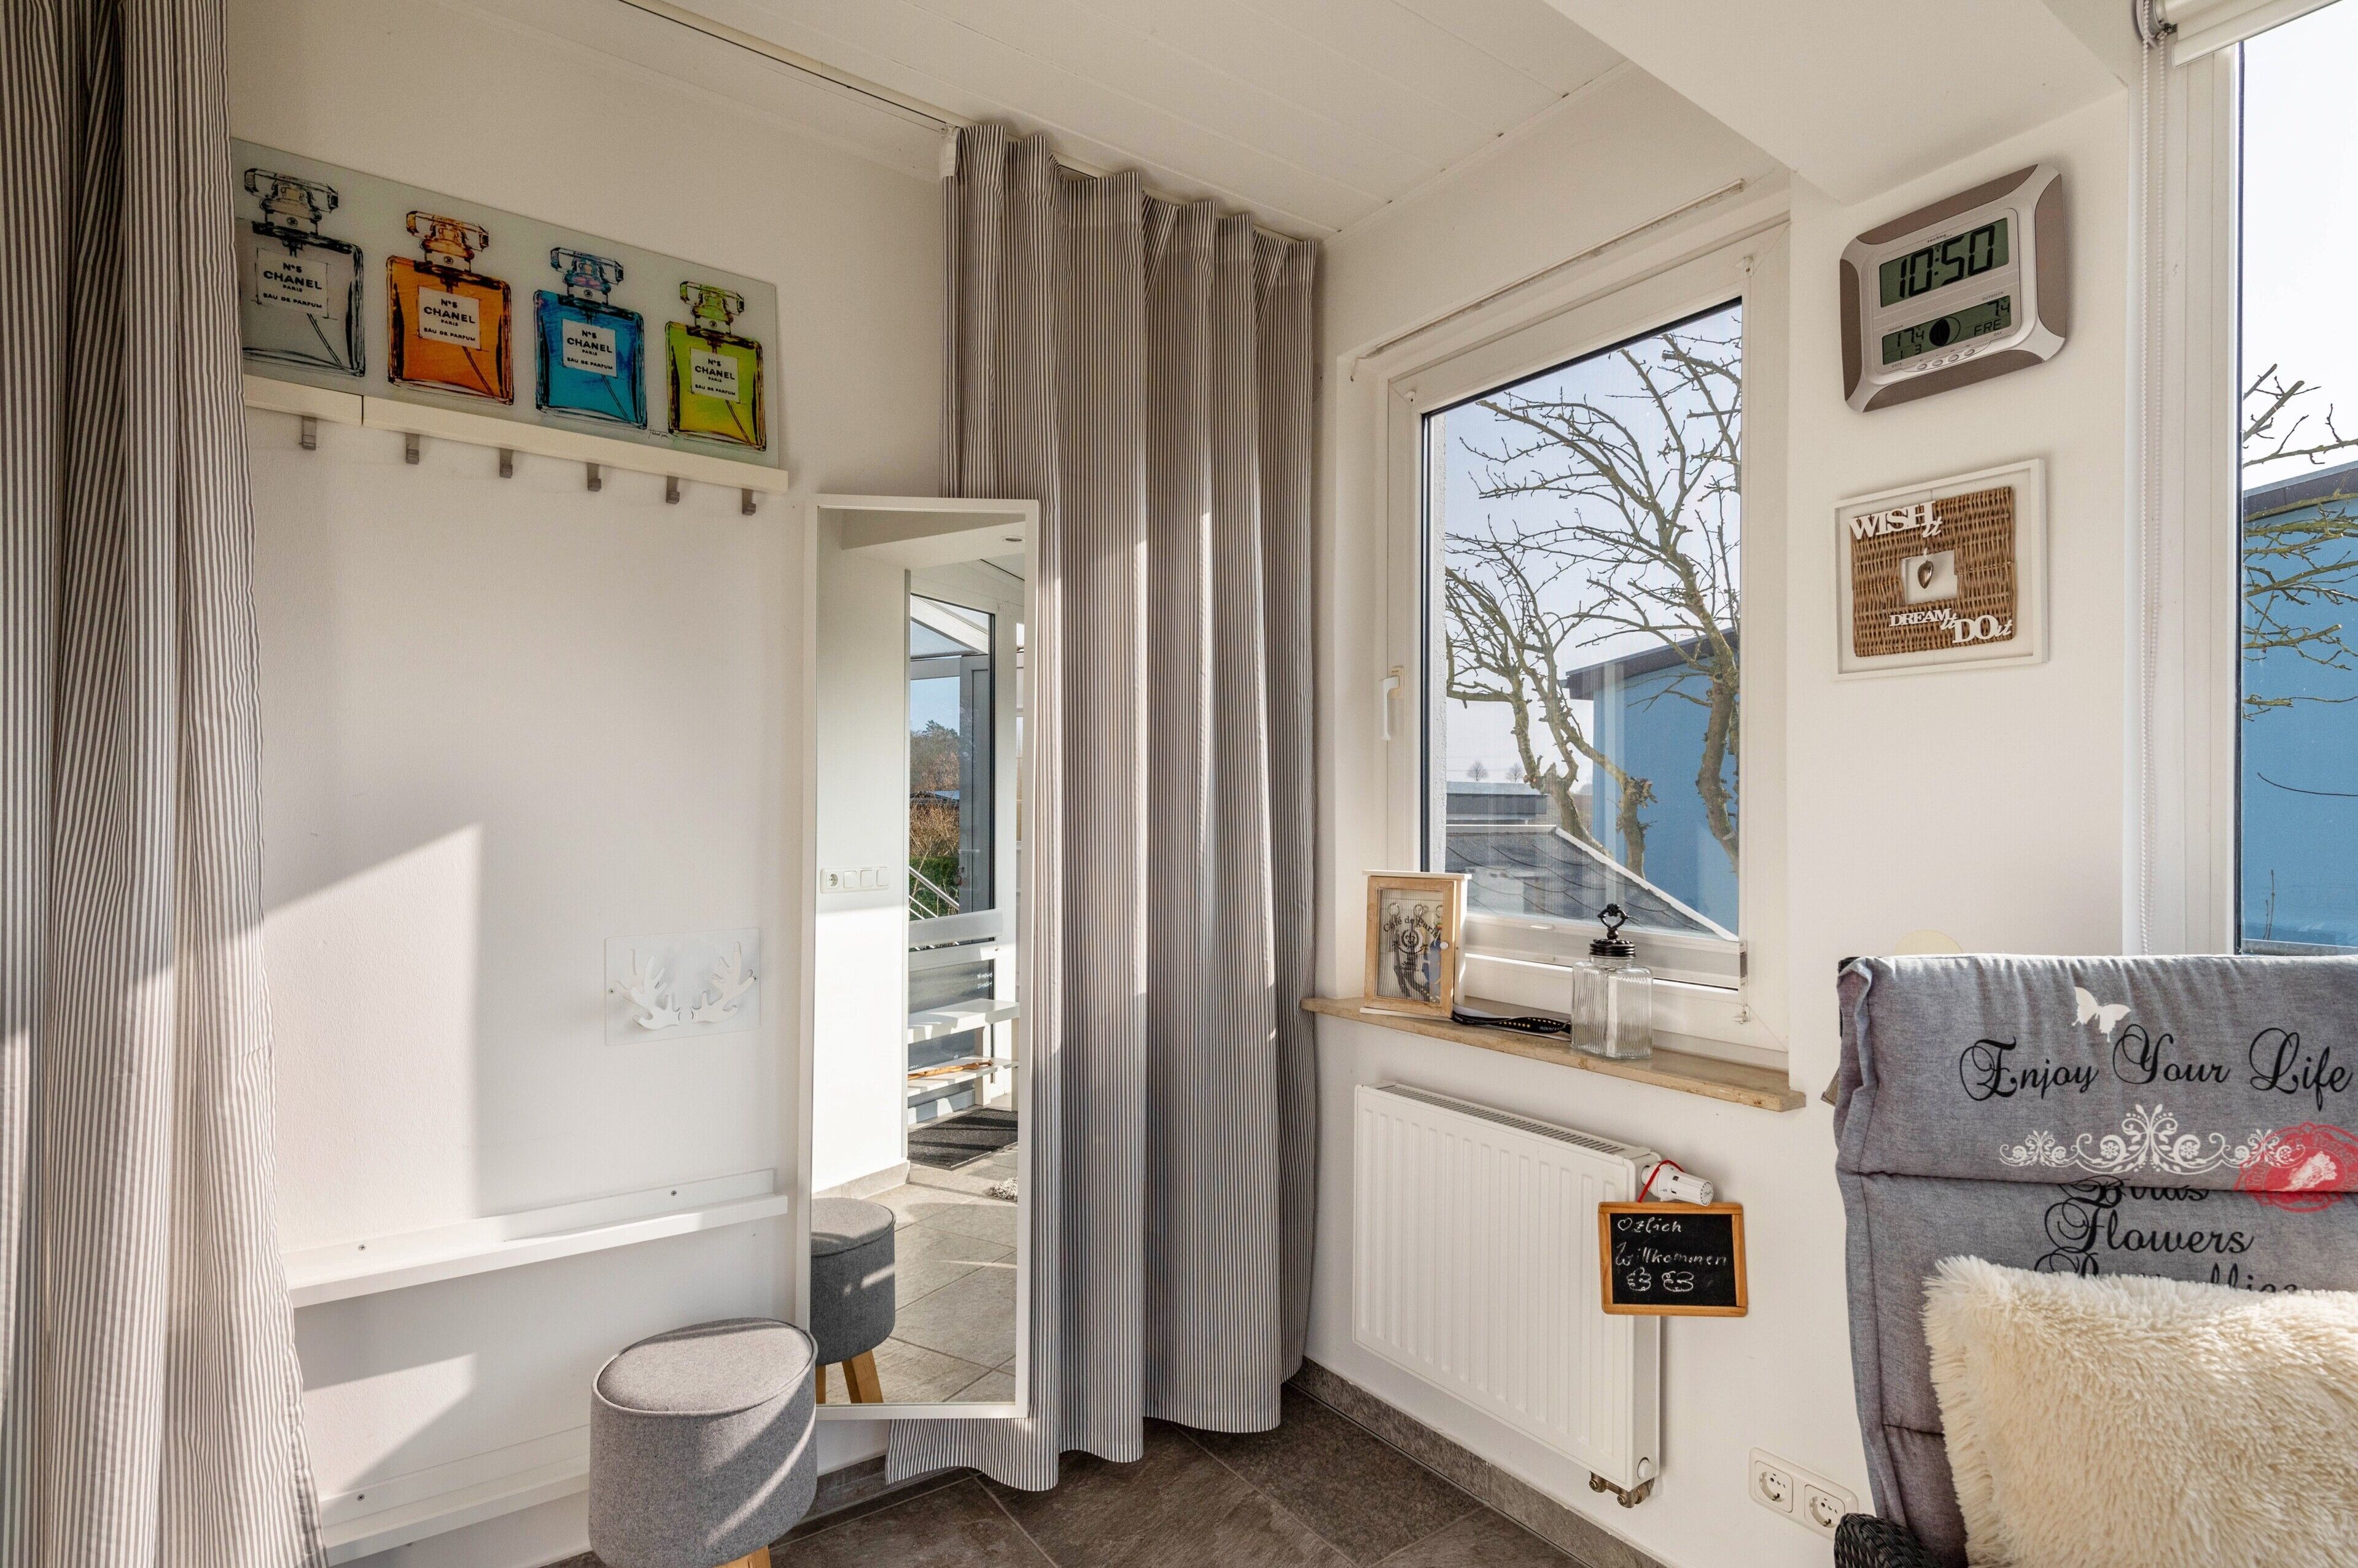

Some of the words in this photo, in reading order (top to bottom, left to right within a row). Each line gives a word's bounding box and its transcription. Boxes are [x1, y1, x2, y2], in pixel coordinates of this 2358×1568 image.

[1899, 224, 1996, 298] 10:50
[263, 270, 322, 290] CHANEL
[293, 298, 322, 309] PARFUM
[424, 306, 476, 324] CHANEL
[450, 333, 476, 341] PARFUM
[1974, 319, 2002, 336] FRE
[567, 337, 613, 354] CHANEL
[695, 365, 736, 380] CHANEL
[1848, 500, 1936, 540] WISH
[1921, 516, 1942, 538] it
[1889, 608, 1951, 627] DREAM
[1951, 614, 1999, 643] DO
[1994, 619, 2013, 637] it
[1959, 1035, 2099, 1101] Enjoy
[2112, 1023, 2232, 1085] Your
[2249, 1027, 2354, 1112] Life
[2044, 1197, 2254, 1254] Flowers
